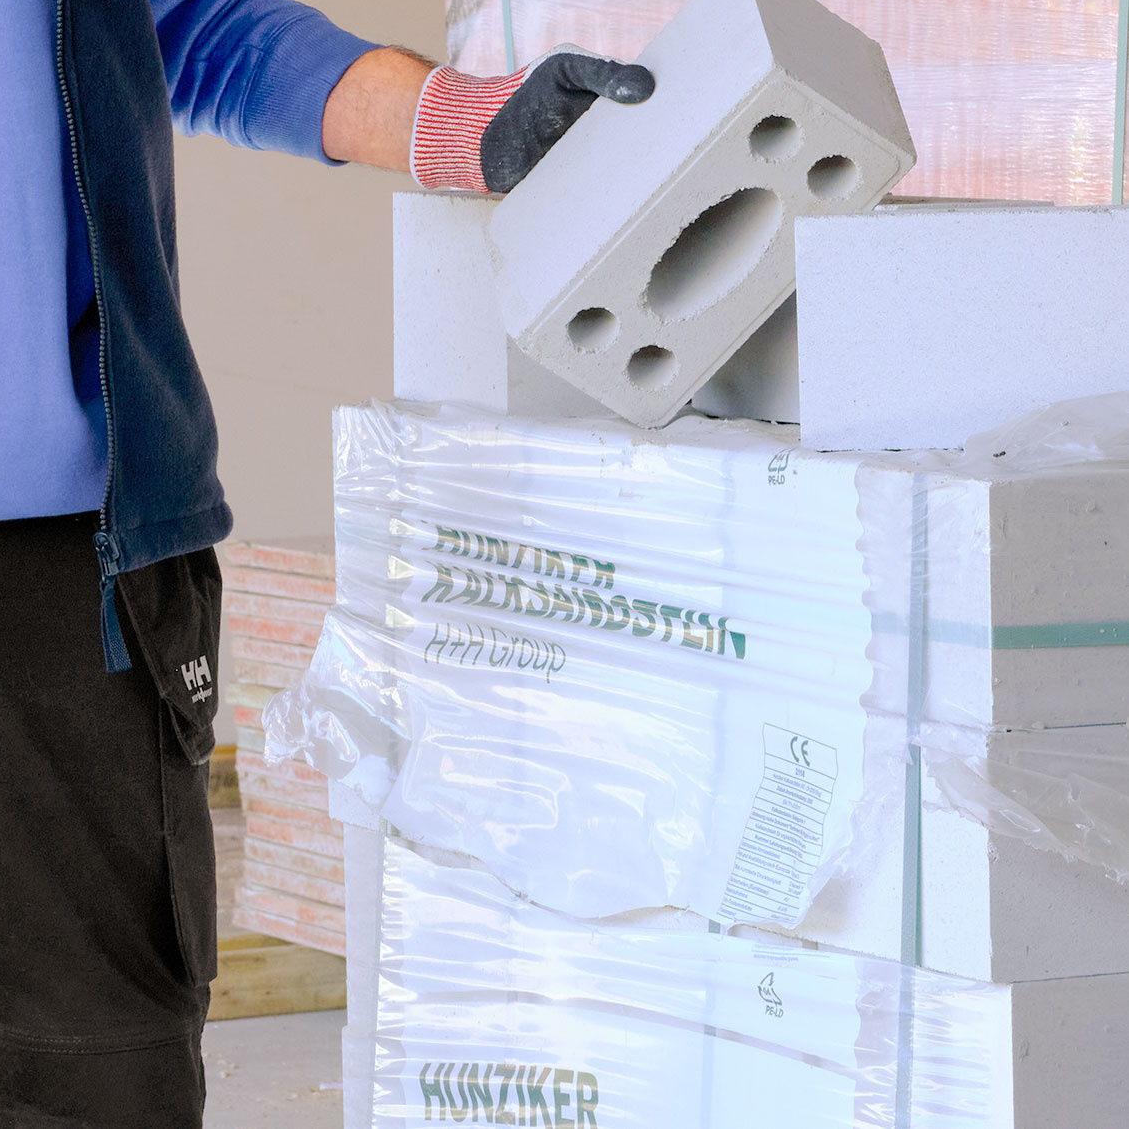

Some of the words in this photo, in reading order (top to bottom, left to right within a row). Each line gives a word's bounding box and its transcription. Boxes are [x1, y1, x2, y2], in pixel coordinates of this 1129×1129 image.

[768, 474, 786, 485] PE-LD
[424, 622, 487, 666] H+H
[488, 627, 567, 684] Group
[180, 655, 212, 691] HH
[764, 1004, 784, 1019] PE-LD
[420, 1062, 600, 1129] HUNZIKER
